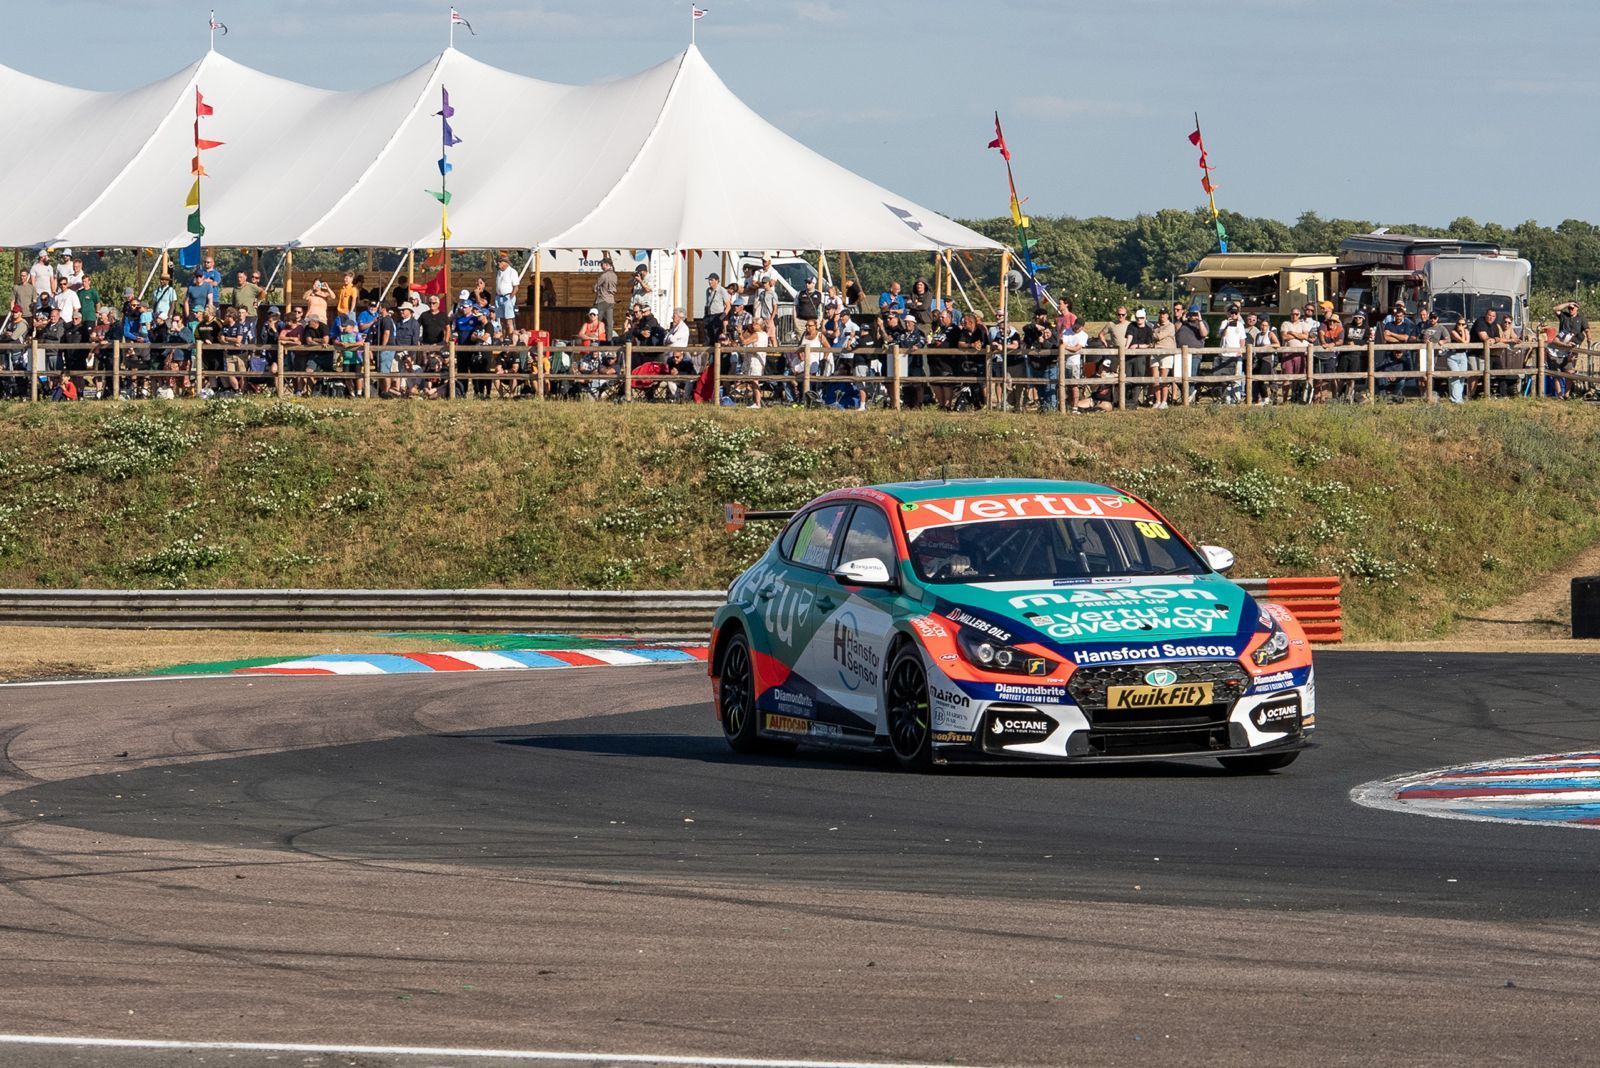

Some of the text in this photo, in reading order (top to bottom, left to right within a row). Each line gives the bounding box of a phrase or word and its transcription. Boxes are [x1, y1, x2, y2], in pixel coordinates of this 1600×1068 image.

[1134, 521, 1171, 539] 80
[1076, 600, 1141, 608] FREIGHT
[1173, 606, 1229, 620] Car
[958, 612, 1012, 641] MILLERS OILS
[1047, 617, 1214, 637] Giveaway
[1074, 643, 1236, 664] Hansford Sensors
[995, 683, 1066, 696] Diamondbrite
[1267, 705, 1297, 718] OCTANE
[1005, 720, 1048, 730] OCTANE
[931, 732, 973, 742] OODYEAR
